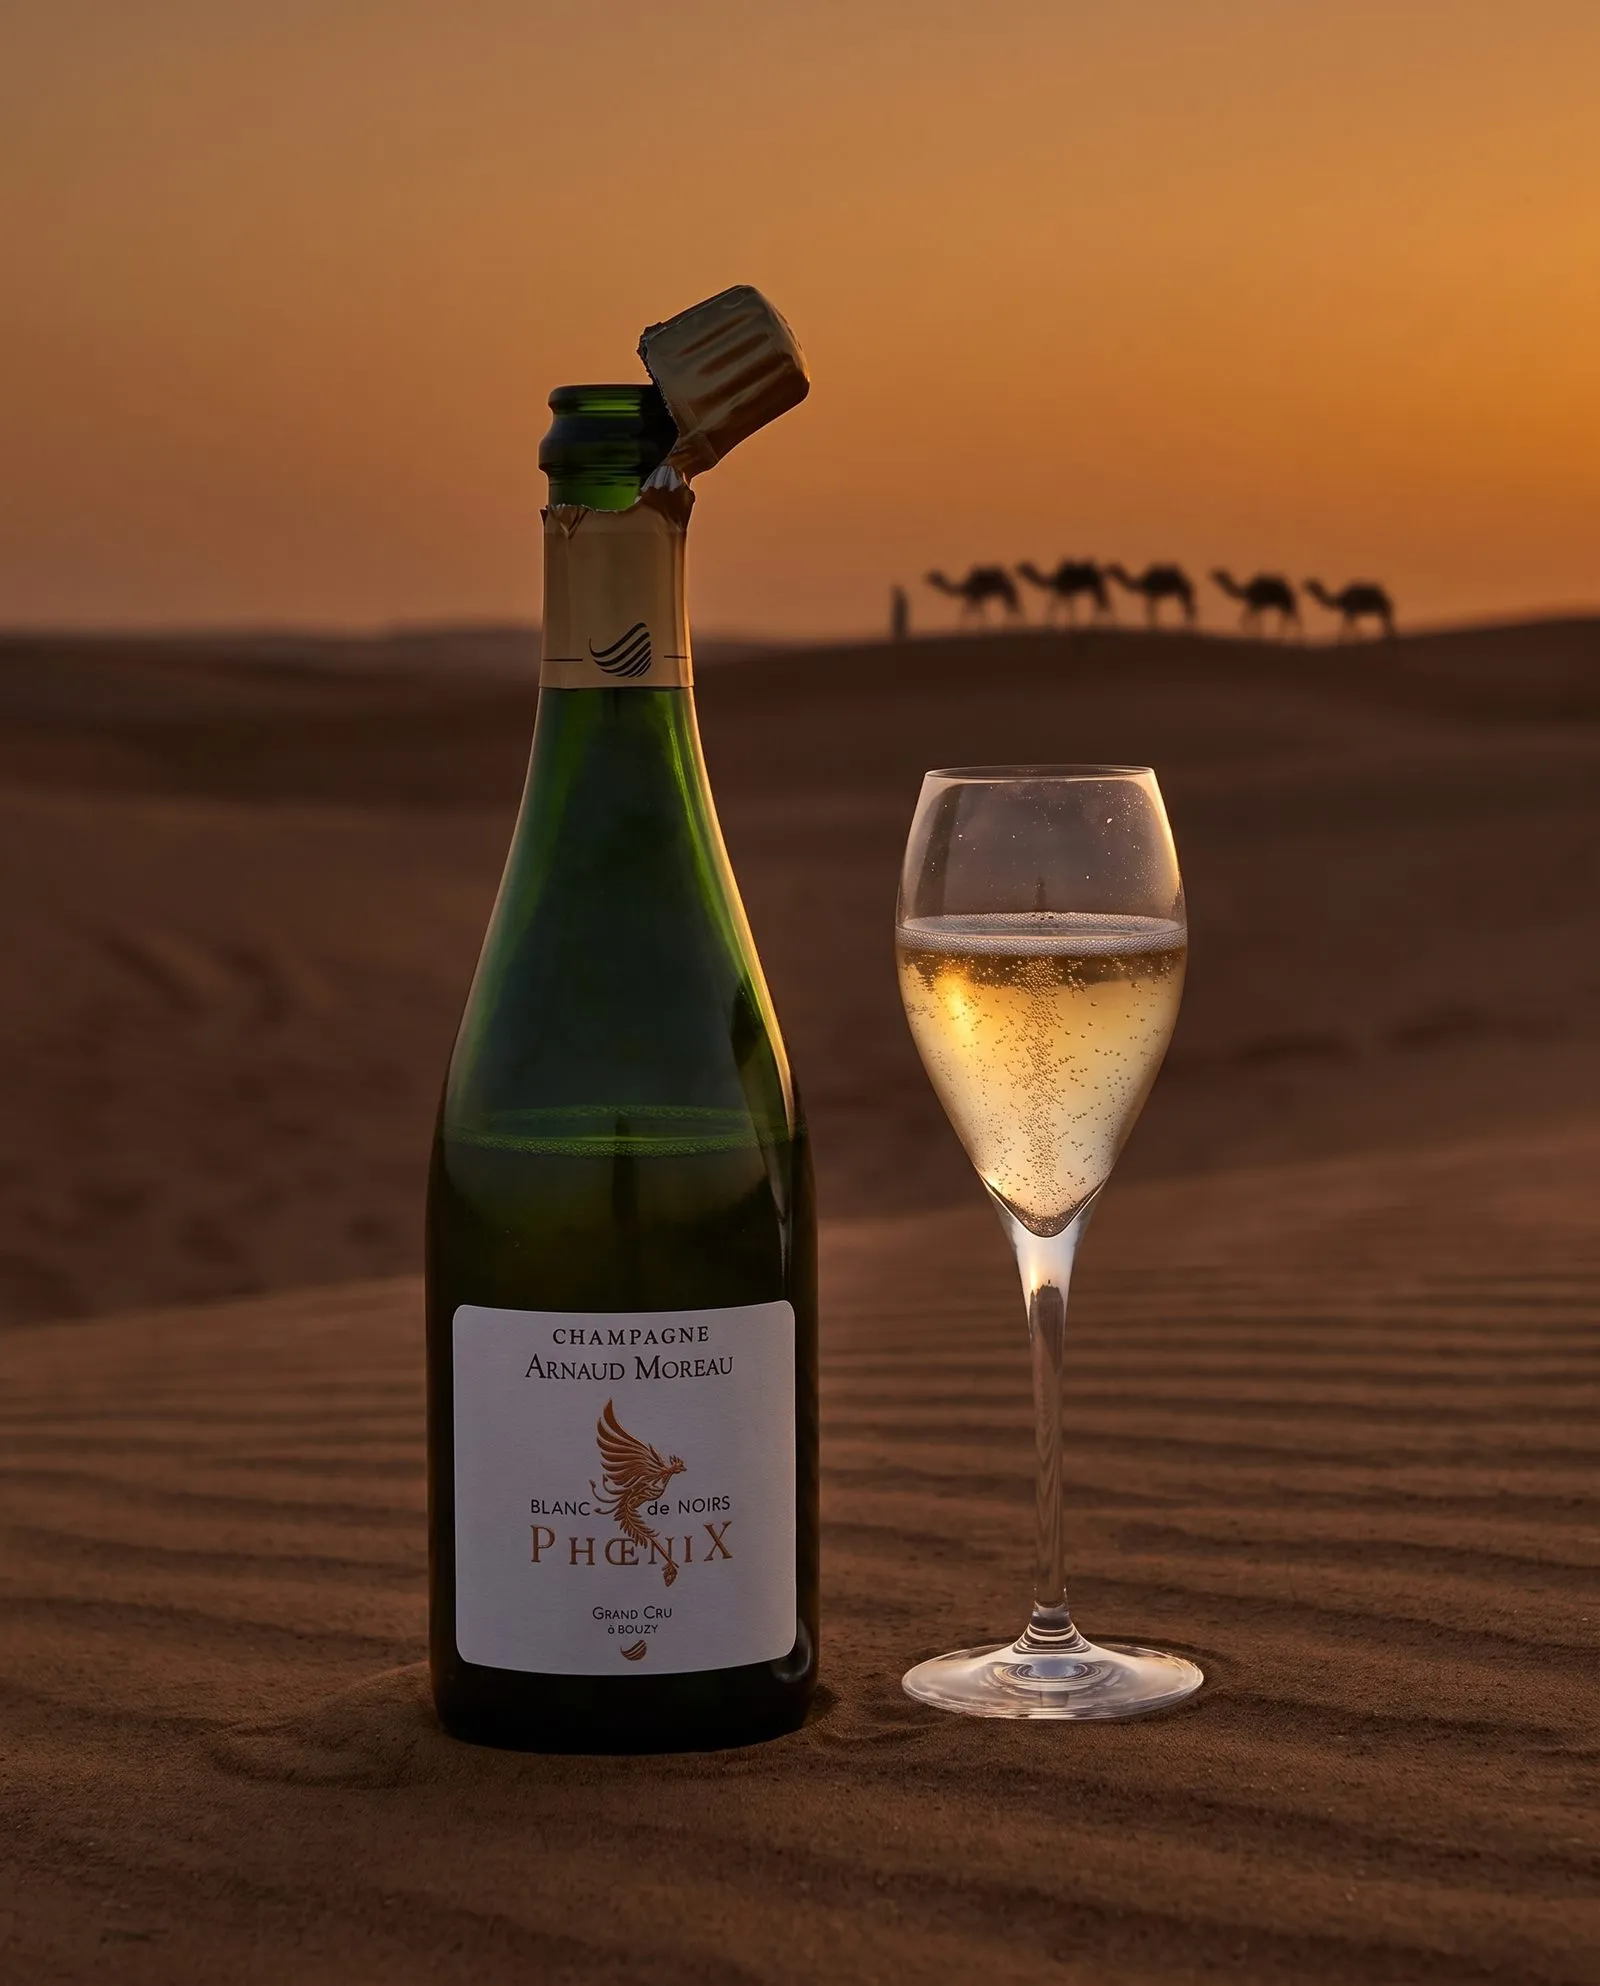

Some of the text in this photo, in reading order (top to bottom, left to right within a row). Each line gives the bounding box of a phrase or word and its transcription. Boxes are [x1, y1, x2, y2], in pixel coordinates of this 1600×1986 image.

[552, 1325, 710, 1346] CHAMPAGNE
[524, 1353, 735, 1381] ARNAUD MOREAU
[530, 1495, 731, 1517] BLANC de NOIRS
[530, 1521, 732, 1566] PHŒNIX
[592, 1605, 673, 1620] GRAND CRU
[617, 1623, 659, 1635] BOUZY
